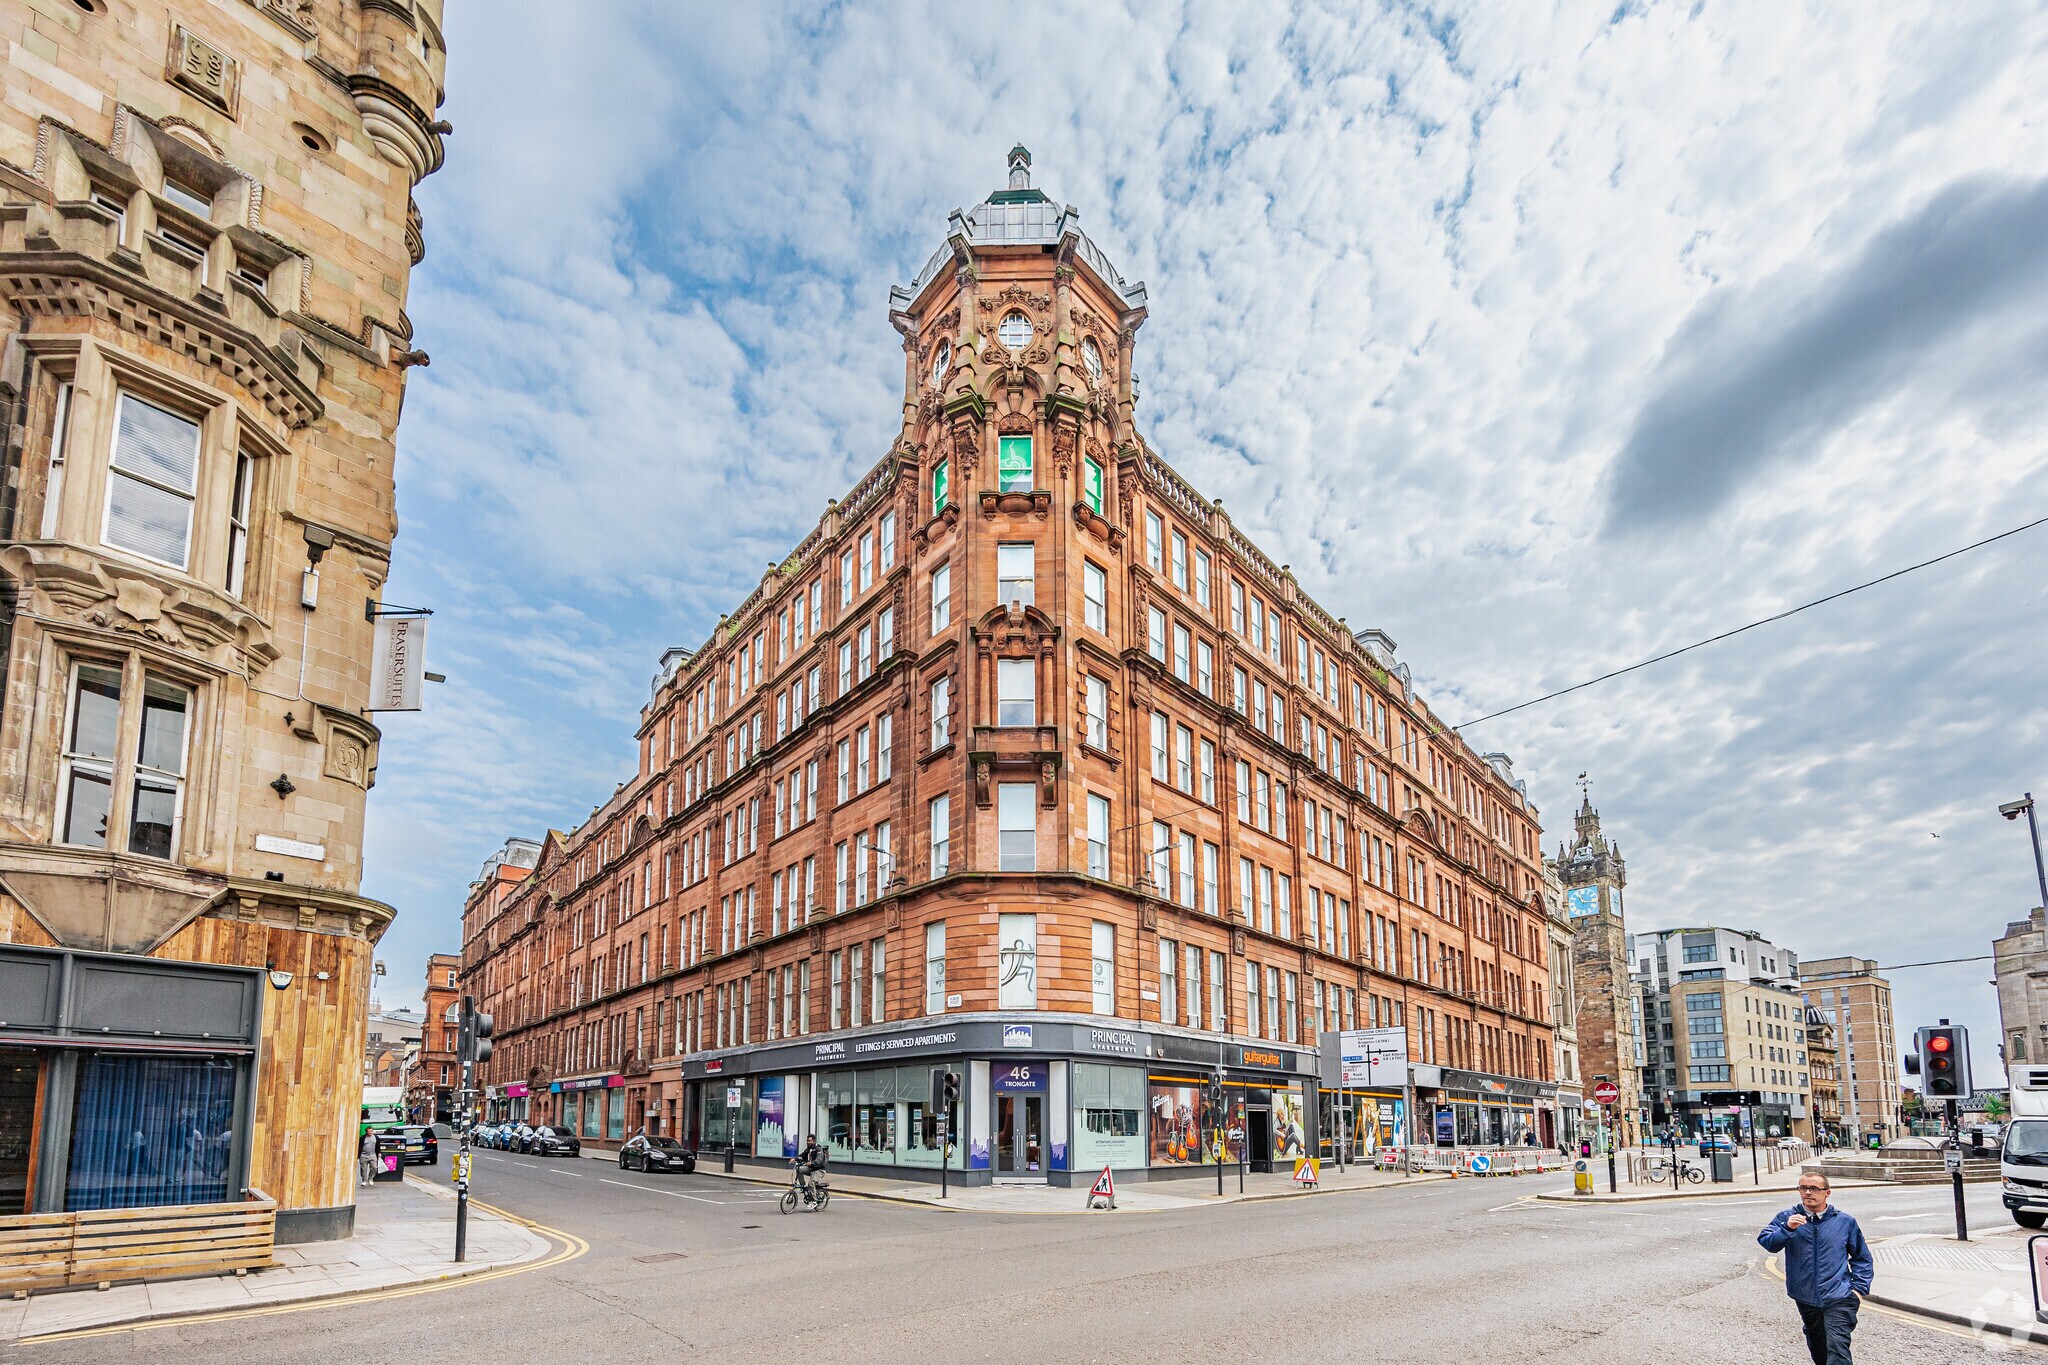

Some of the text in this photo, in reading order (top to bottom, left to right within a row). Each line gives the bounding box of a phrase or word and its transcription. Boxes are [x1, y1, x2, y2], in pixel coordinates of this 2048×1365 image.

[855, 1032, 956, 1053] LETTINGS & SERVICED APARTMENTS
[1091, 1029, 1137, 1046] PRINCIPAL
[815, 1042, 845, 1055] PRINCIPAL
[1092, 1043, 1137, 1053] APARTMENTS
[815, 1053, 845, 1061] APARTMENTS
[1010, 1066, 1030, 1080] 46
